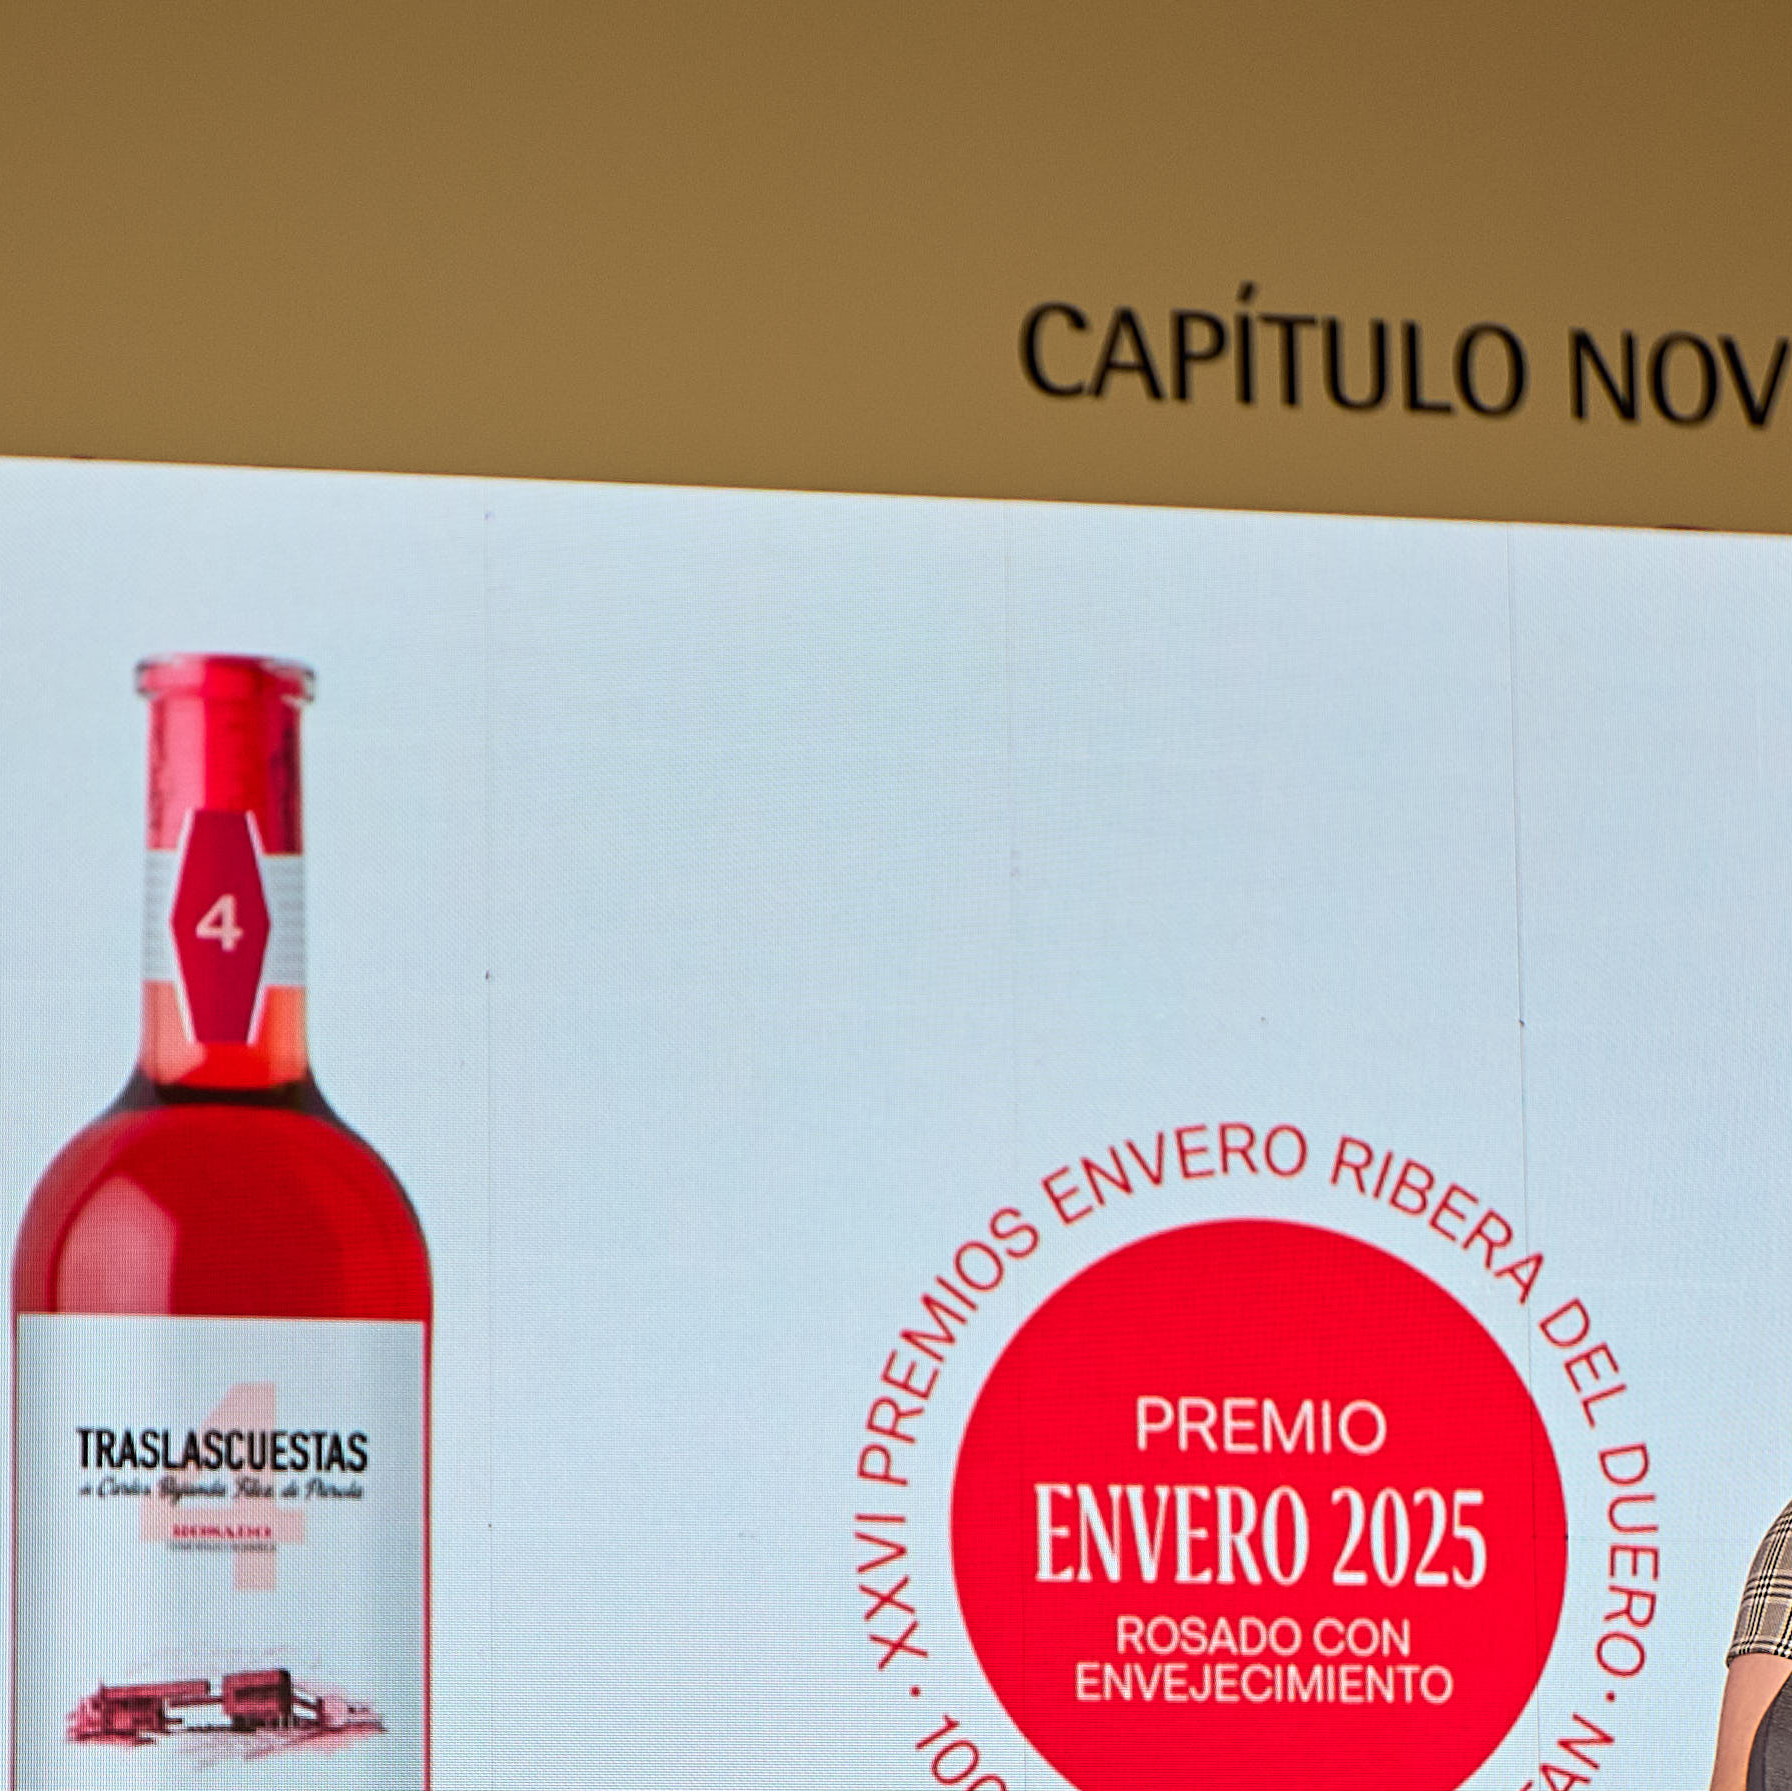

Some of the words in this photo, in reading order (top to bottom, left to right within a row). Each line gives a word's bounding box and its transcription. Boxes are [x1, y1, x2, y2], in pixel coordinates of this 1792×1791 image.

[1017, 279, 1530, 420] CAPÍTULO
[194, 893, 244, 952] 4
[1038, 1119, 1309, 1228] ENVERO
[1327, 1133, 1545, 1306] RIBERA
[854, 1204, 1041, 1488] PREMIOS
[1535, 1295, 1627, 1428] DEL
[76, 1426, 369, 1474] TRASLASCUESTAS
[1134, 1393, 1389, 1457] PREMIO
[1033, 1481, 1311, 1587] ENVERO
[1329, 1485, 1488, 1589] 2025
[1592, 1441, 1661, 1680] DUERO
[852, 1512, 929, 1671] XXVI
[1114, 1613, 1302, 1657] ROSADO
[1312, 1615, 1412, 1659] CON
[1073, 1660, 1455, 1706] ENVEJECIMIENTO
